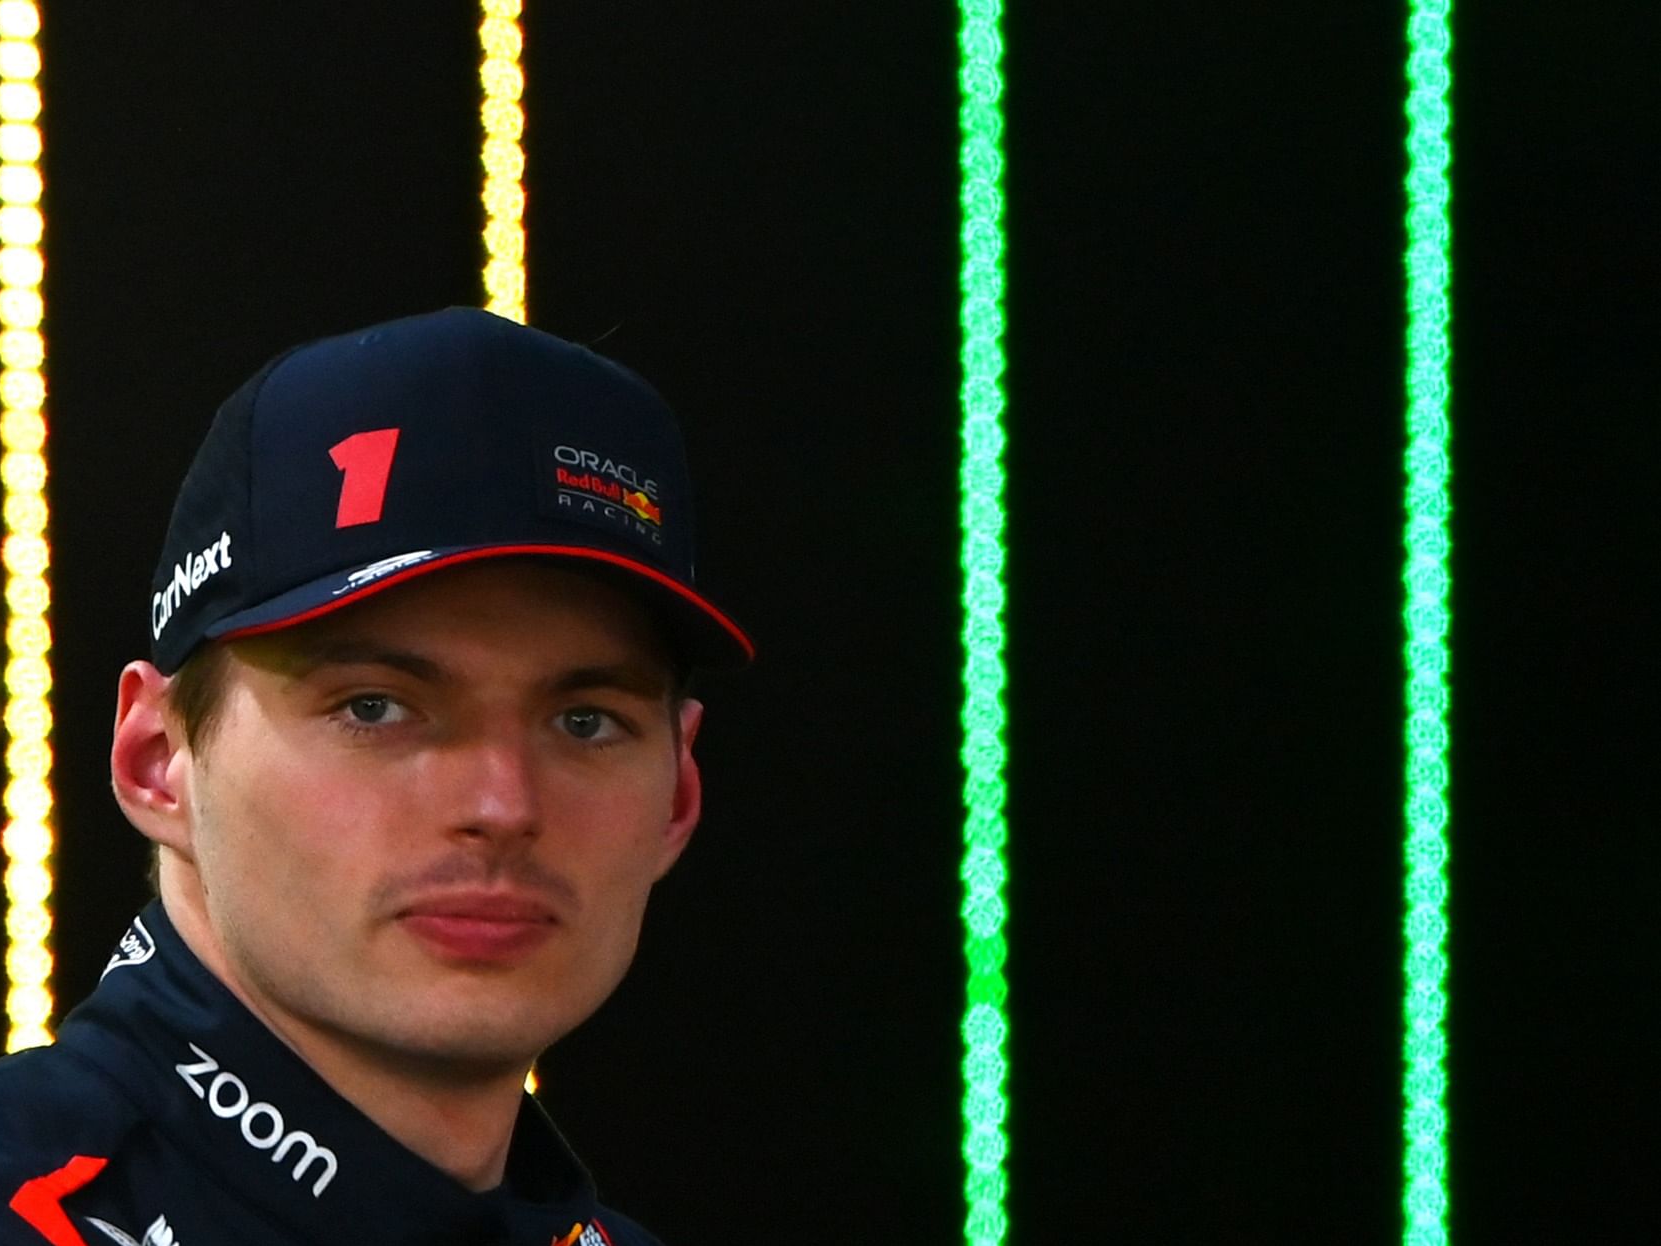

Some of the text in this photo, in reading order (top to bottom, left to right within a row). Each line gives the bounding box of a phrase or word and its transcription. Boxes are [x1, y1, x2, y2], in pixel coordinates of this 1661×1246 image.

[328, 427, 399, 528] 1
[554, 445, 658, 500] ORACLE
[556, 467, 620, 500] Red Bull
[558, 494, 661, 545] RACING
[152, 530, 232, 641] CarNext
[175, 1042, 338, 1198] zoom
